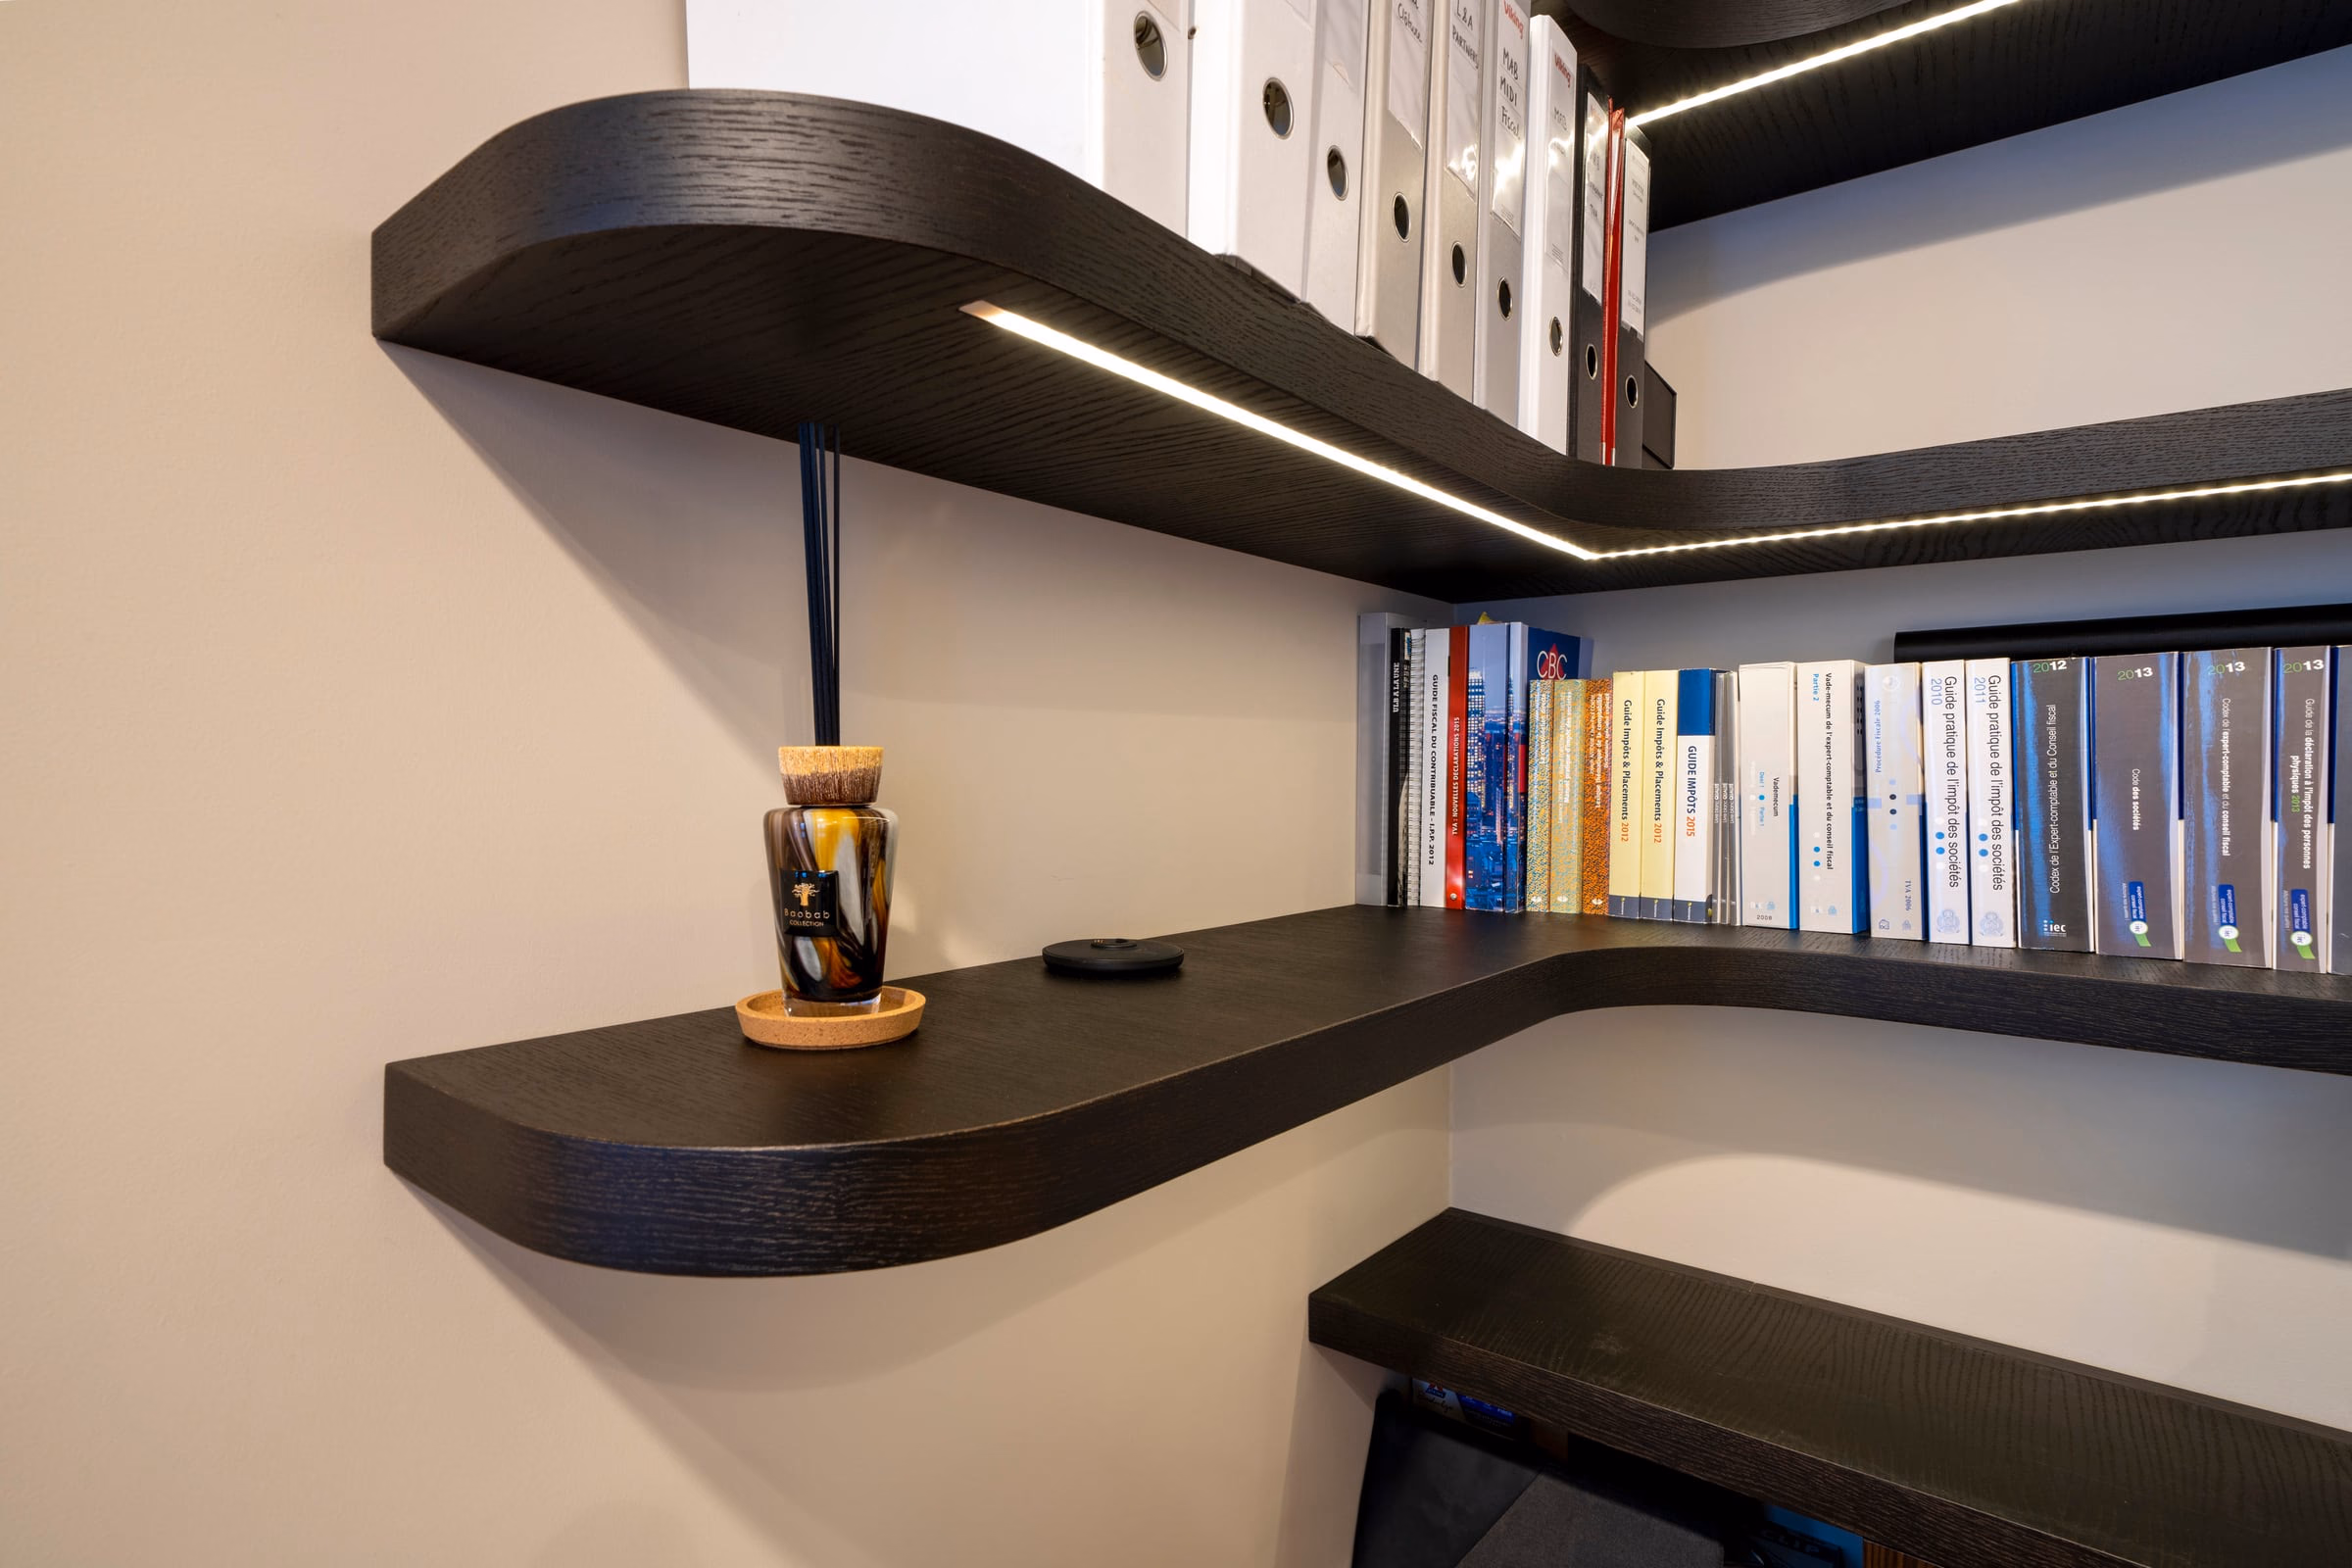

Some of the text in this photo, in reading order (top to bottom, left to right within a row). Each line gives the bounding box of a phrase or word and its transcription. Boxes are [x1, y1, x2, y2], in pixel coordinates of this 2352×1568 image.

[1503, 47, 1518, 80] MAB
[1554, 52, 1571, 88] Viking
[1500, 76, 1517, 106] MIDI
[1501, 105, 1520, 140] Fiscal
[1537, 650, 1568, 680] CBC
[2033, 660, 2067, 673] 2012
[2117, 666, 2153, 681] 2013
[2208, 661, 2246, 675] 2013
[2282, 659, 2325, 674] 2013
[1931, 678, 1942, 706] 2010
[1974, 677, 1986, 704] 2011
[1623, 700, 1632, 726] Guide
[1656, 699, 1665, 725] Guide
[2046, 705, 2057, 725] fiscal
[2222, 698, 2231, 718] Codex
[2305, 698, 2315, 718] Guide
[1826, 720, 1833, 730] de
[2222, 719, 2231, 728] de
[2305, 719, 2314, 728] de
[1431, 735, 1437, 749] DU
[1622, 728, 1632, 760] Impôts
[1654, 728, 1665, 760] Impôts
[2047, 726, 2058, 756] Conseil
[1824, 732, 1834, 801] l'expert-comptable
[2048, 758, 2057, 767] du
[2221, 729, 2230, 793] l'expert-comptable
[2304, 737, 2314, 779] déclaration
[1622, 770, 1631, 820] Placements
[1687, 745, 1696, 837] GUIDE IMPÔTS 2015
[1943, 676, 1962, 888] Guide pratique de l'impôt des sociétés
[1986, 675, 2005, 891] Guide pratique de l'impôt des sociétés
[2290, 756, 2301, 812] physiques 2013
[1654, 770, 1664, 821] Placements
[2222, 801, 2230, 809] du
[2302, 787, 2313, 812] l'impôt
[1826, 811, 1834, 821] du
[2047, 780, 2059, 853] l'Expert-comptable
[2132, 801, 2141, 830] sociétés
[2222, 810, 2230, 836] conseil
[2303, 814, 2313, 828] des
[1653, 823, 1662, 843] 2012
[2050, 855, 2059, 865] de
[2222, 837, 2230, 857] fiscal
[2301, 830, 2311, 869] personnes
[2050, 867, 2060, 893] Codex
[784, 907, 830, 919] Baobab
[2050, 919, 2066, 932] iec
